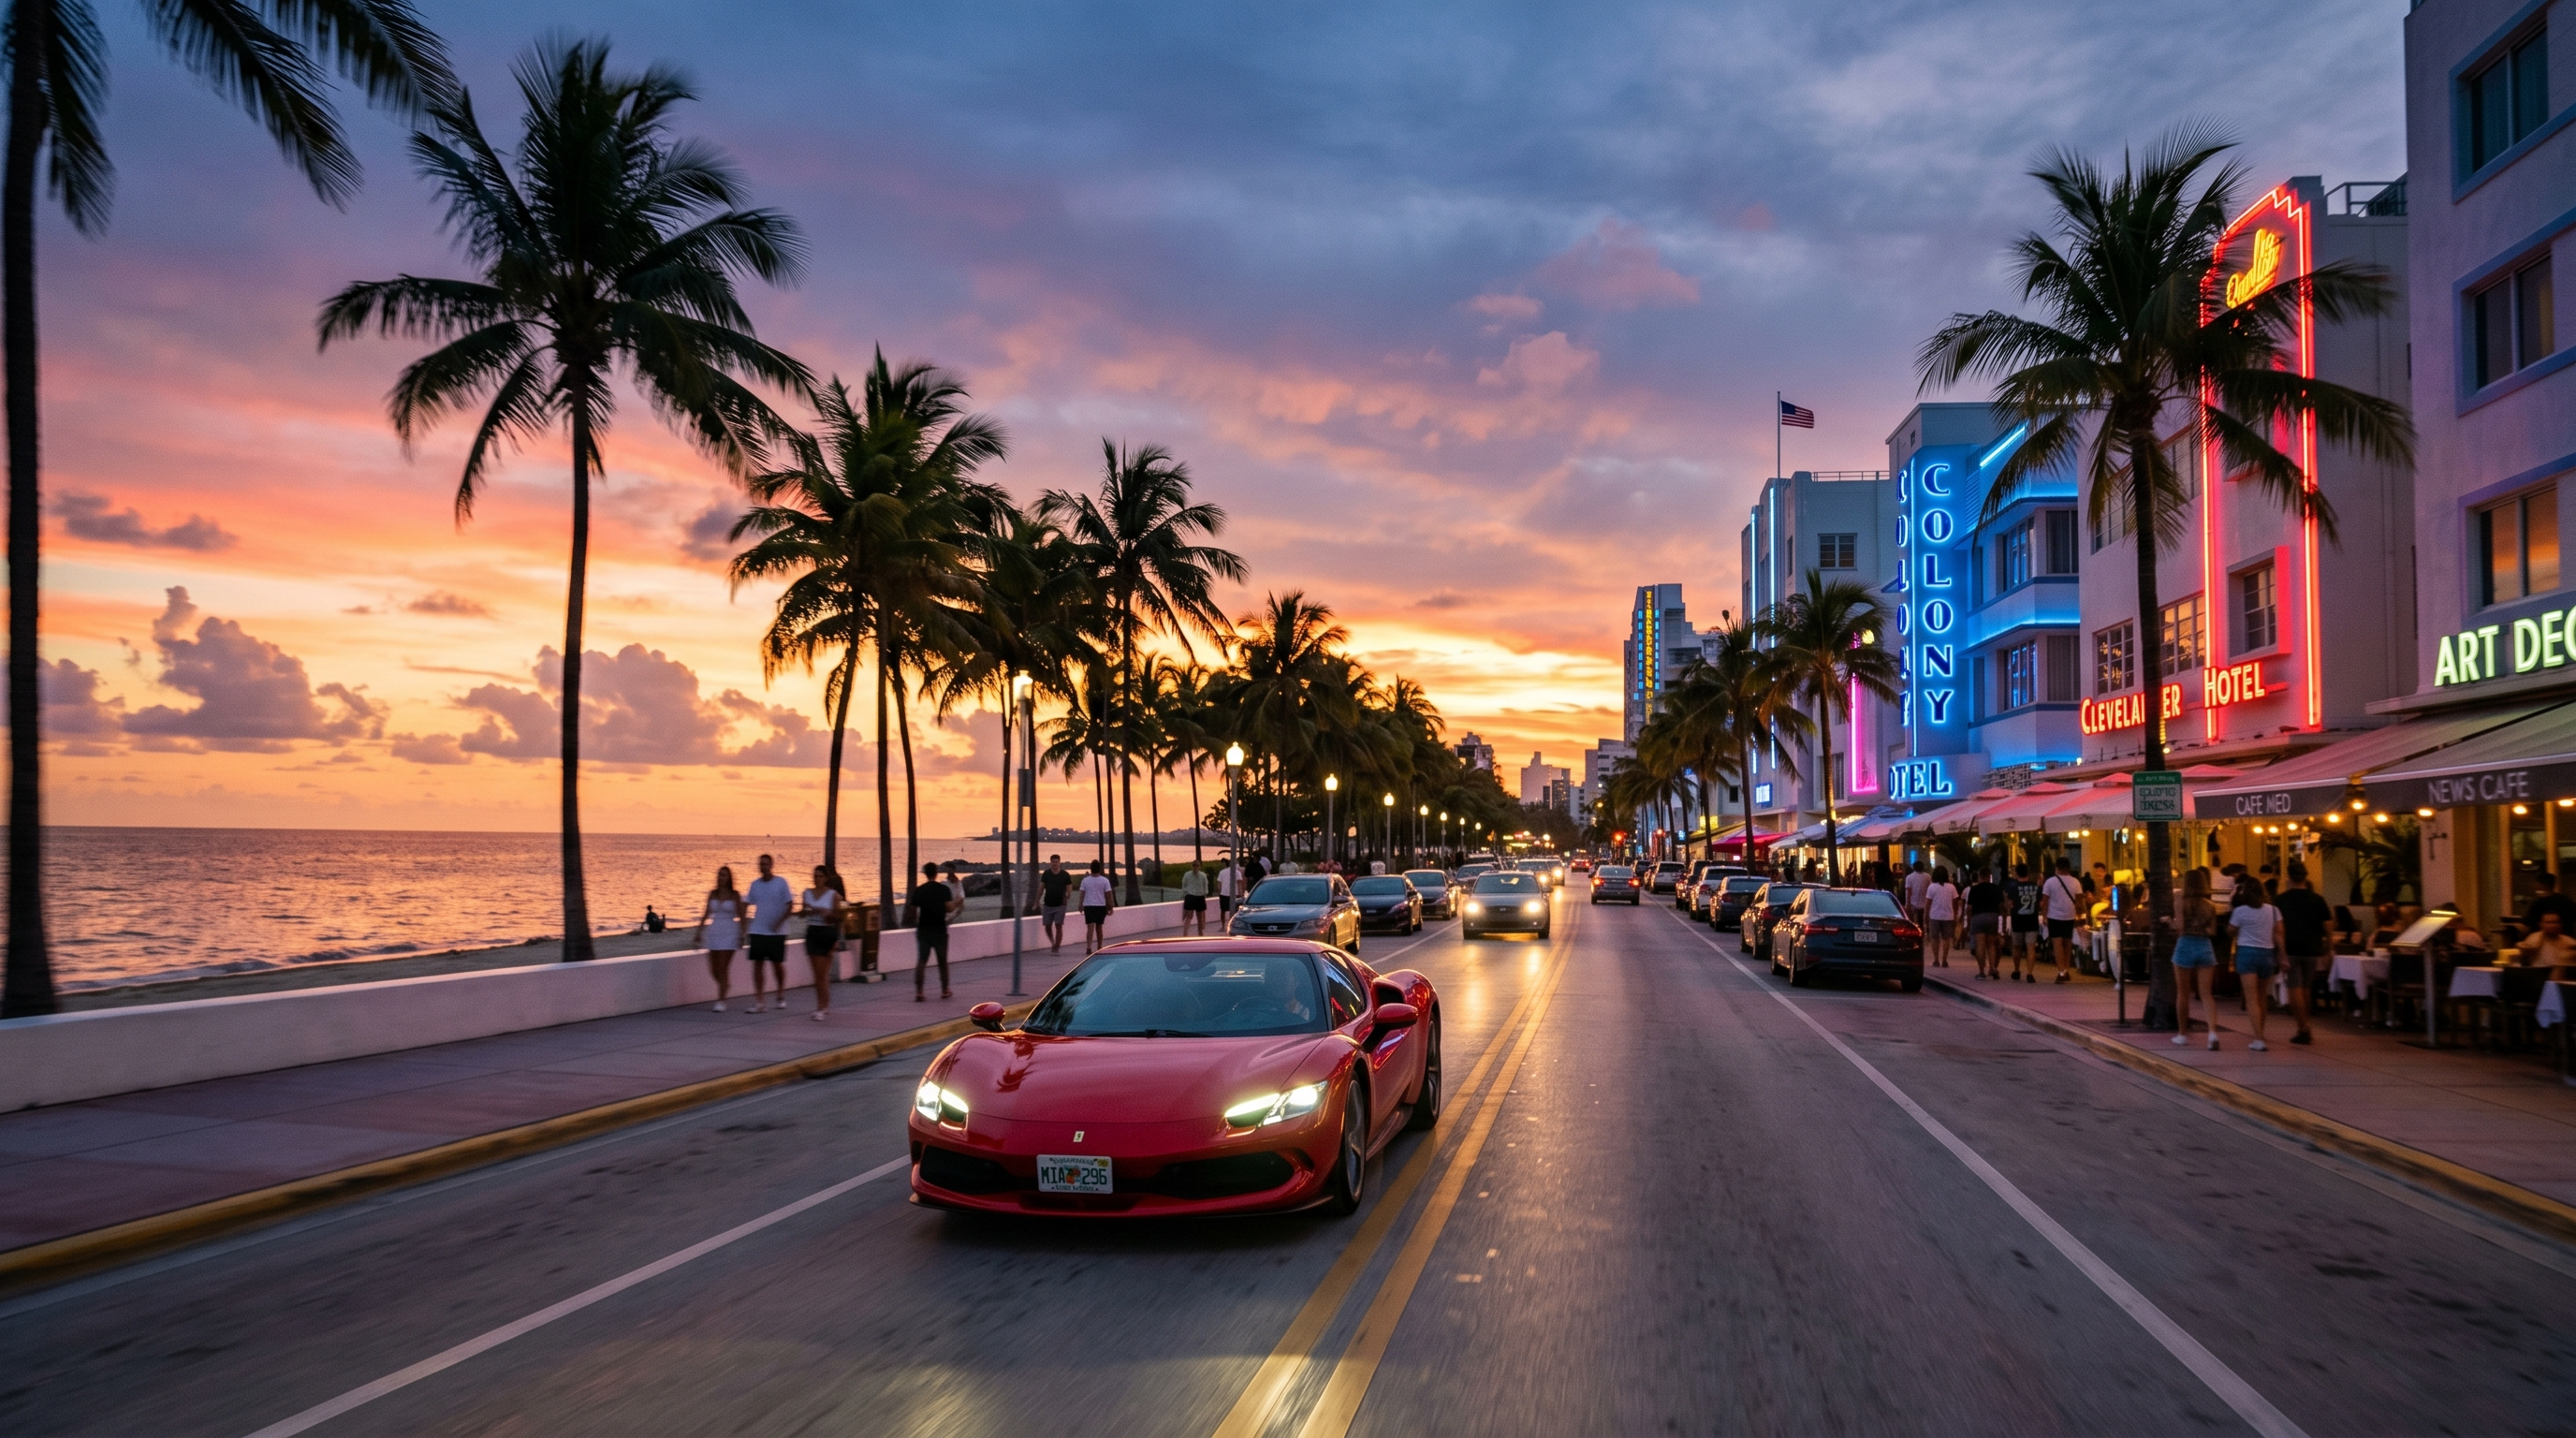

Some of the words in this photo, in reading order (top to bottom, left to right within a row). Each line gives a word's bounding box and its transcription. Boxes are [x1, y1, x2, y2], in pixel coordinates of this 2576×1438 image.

[1922, 462, 1954, 724] COLONY
[2434, 624, 2500, 687] ART
[2081, 683, 2183, 736] CLEVELAER
[2203, 661, 2266, 708] HOTEL
[2235, 794, 2263, 815] CAFE
[2266, 793, 2291, 814] MED
[2427, 776, 2476, 804] NEWS
[2479, 770, 2530, 800] CAFE
[1040, 1167, 1066, 1184] MIA
[1081, 1167, 1107, 1185] 296
